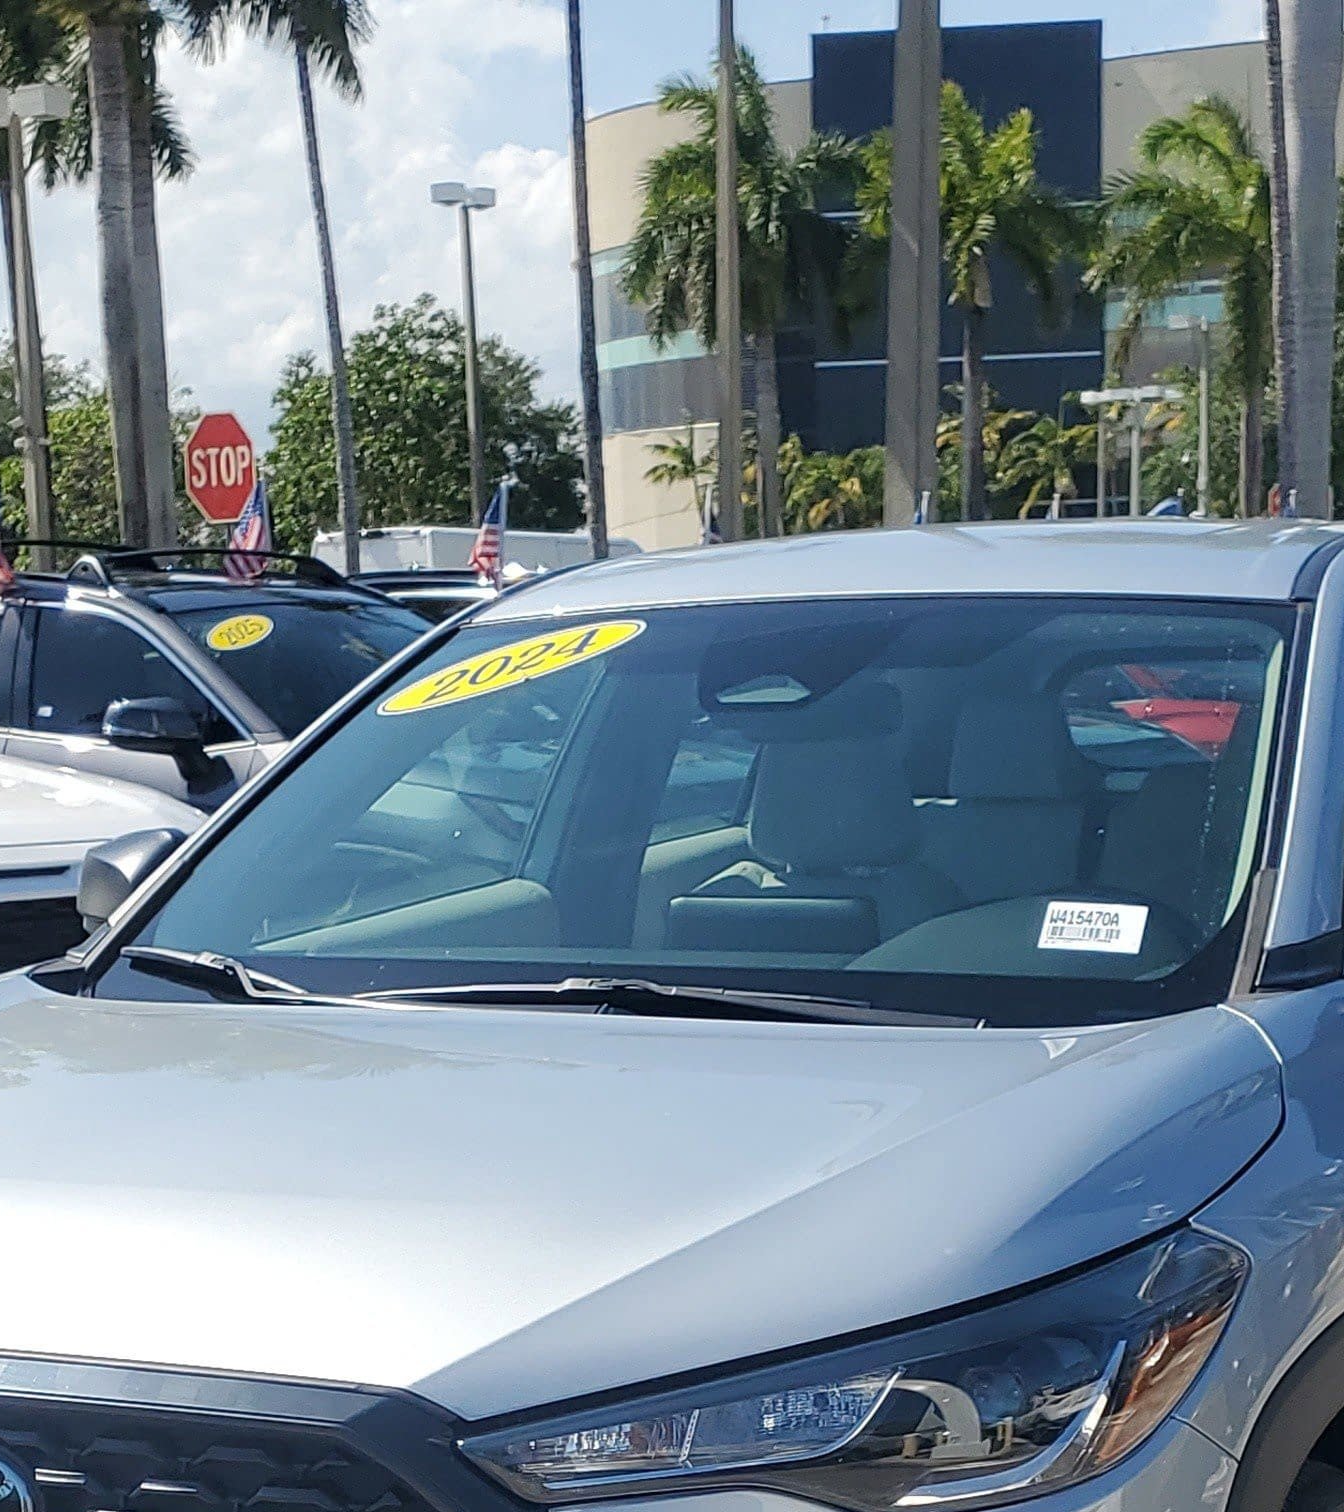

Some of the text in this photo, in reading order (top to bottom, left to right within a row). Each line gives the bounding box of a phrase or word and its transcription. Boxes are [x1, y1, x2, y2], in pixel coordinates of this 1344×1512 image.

[191, 445, 251, 488] STOP
[218, 618, 264, 646] 2025
[421, 628, 601, 704] 2024
[1049, 908, 1120, 927] W415470A
